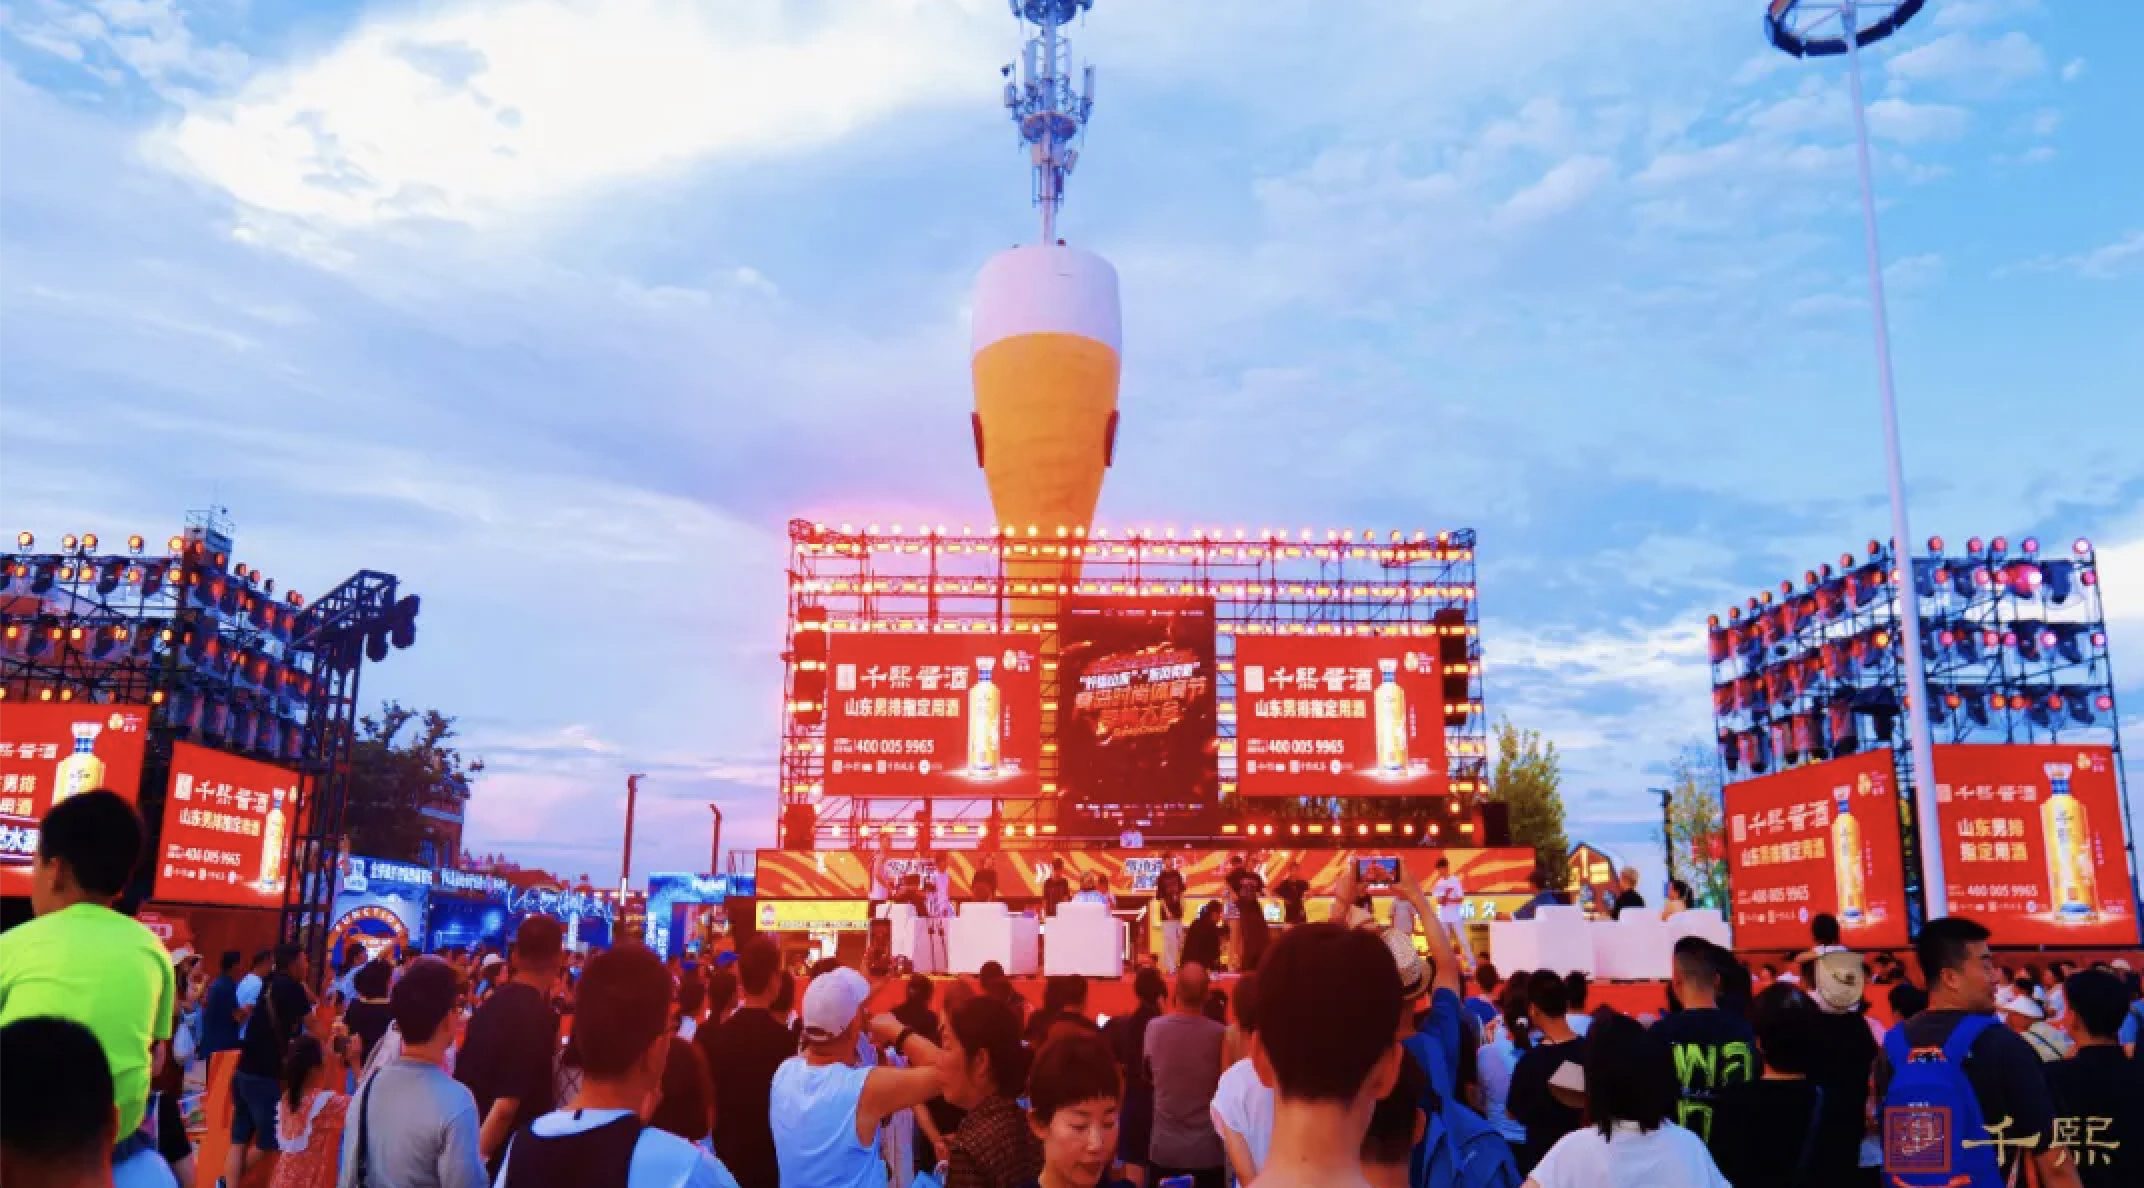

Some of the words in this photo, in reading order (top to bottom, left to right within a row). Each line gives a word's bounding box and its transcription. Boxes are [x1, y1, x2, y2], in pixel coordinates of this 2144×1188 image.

[1268, 666, 1374, 692] 千熙酱酒
[845, 697, 961, 718] 山东男排指定用酒
[1255, 698, 1367, 719] 山东男排指定用酒
[857, 739, 880, 754] 400
[905, 739, 935, 754] 9965
[1269, 739, 1290, 754] 400
[1315, 739, 1345, 754] 9965
[1957, 817, 2024, 837] 山东男排
[1960, 841, 2028, 862] 指定用酒
